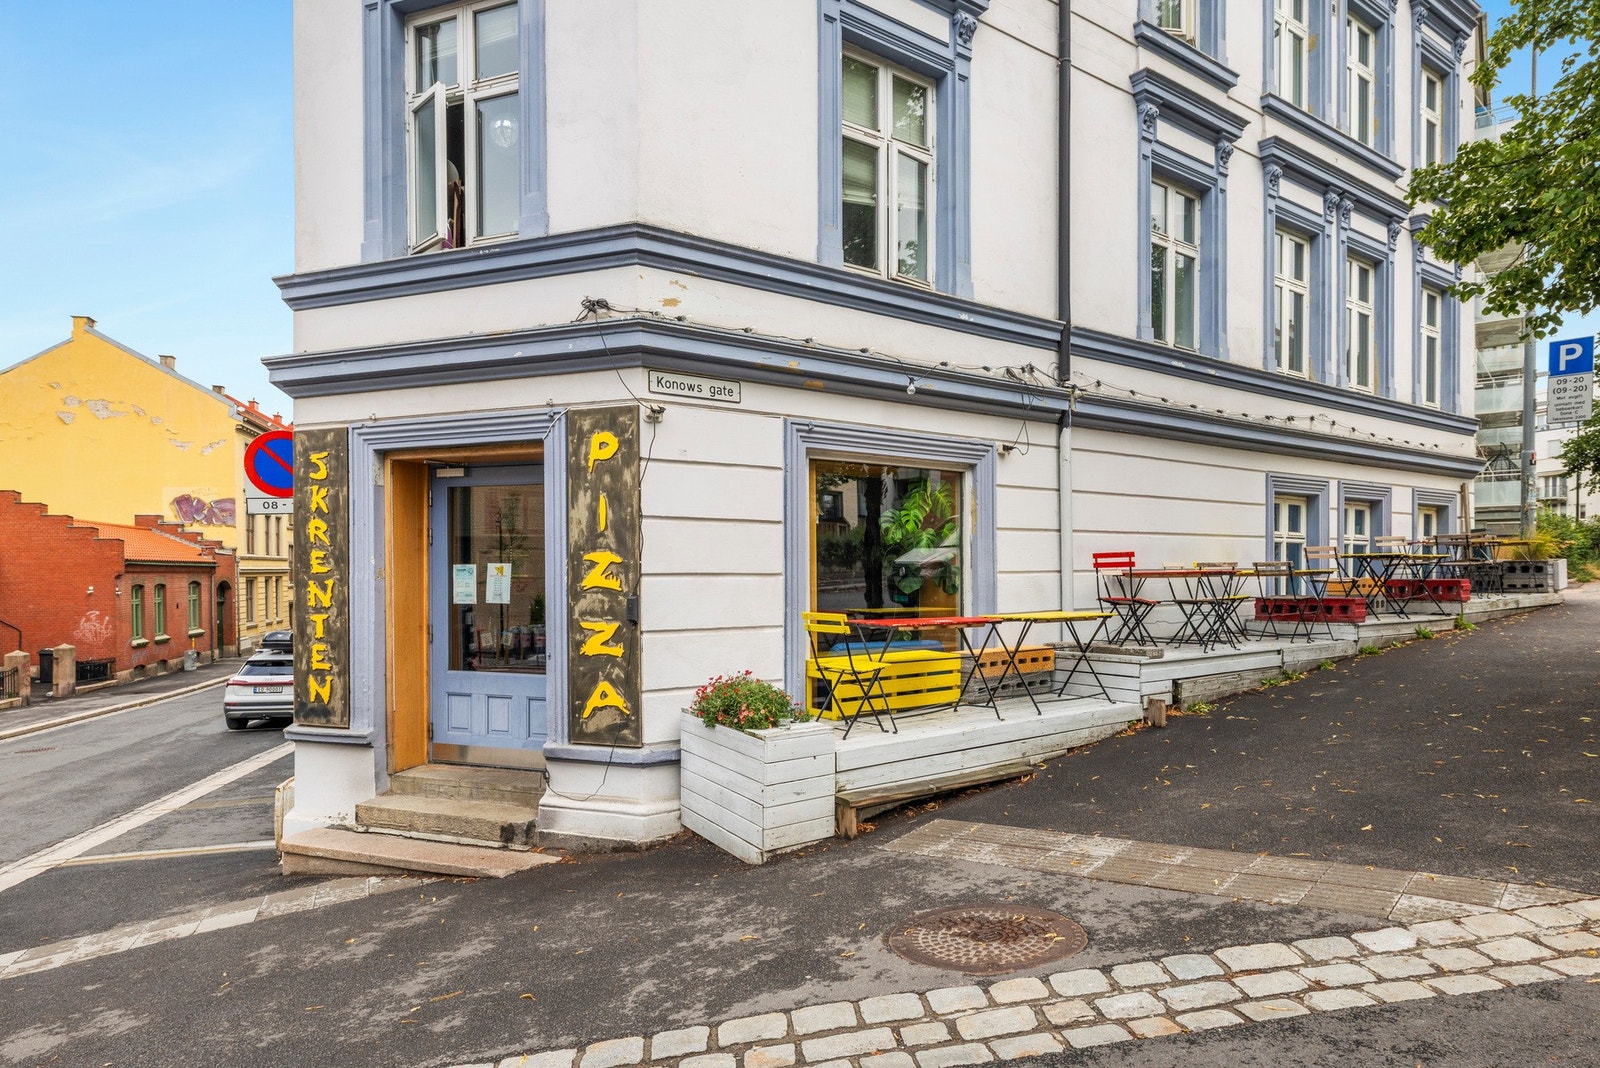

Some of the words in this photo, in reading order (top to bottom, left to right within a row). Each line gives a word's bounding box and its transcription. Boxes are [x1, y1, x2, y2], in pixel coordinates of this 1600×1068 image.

[656, 375, 703, 393] Konows
[709, 385, 734, 398] gate
[1559, 343, 1583, 371] P
[307, 451, 333, 706] SKRENTEN
[578, 430, 631, 720] PIZZA
